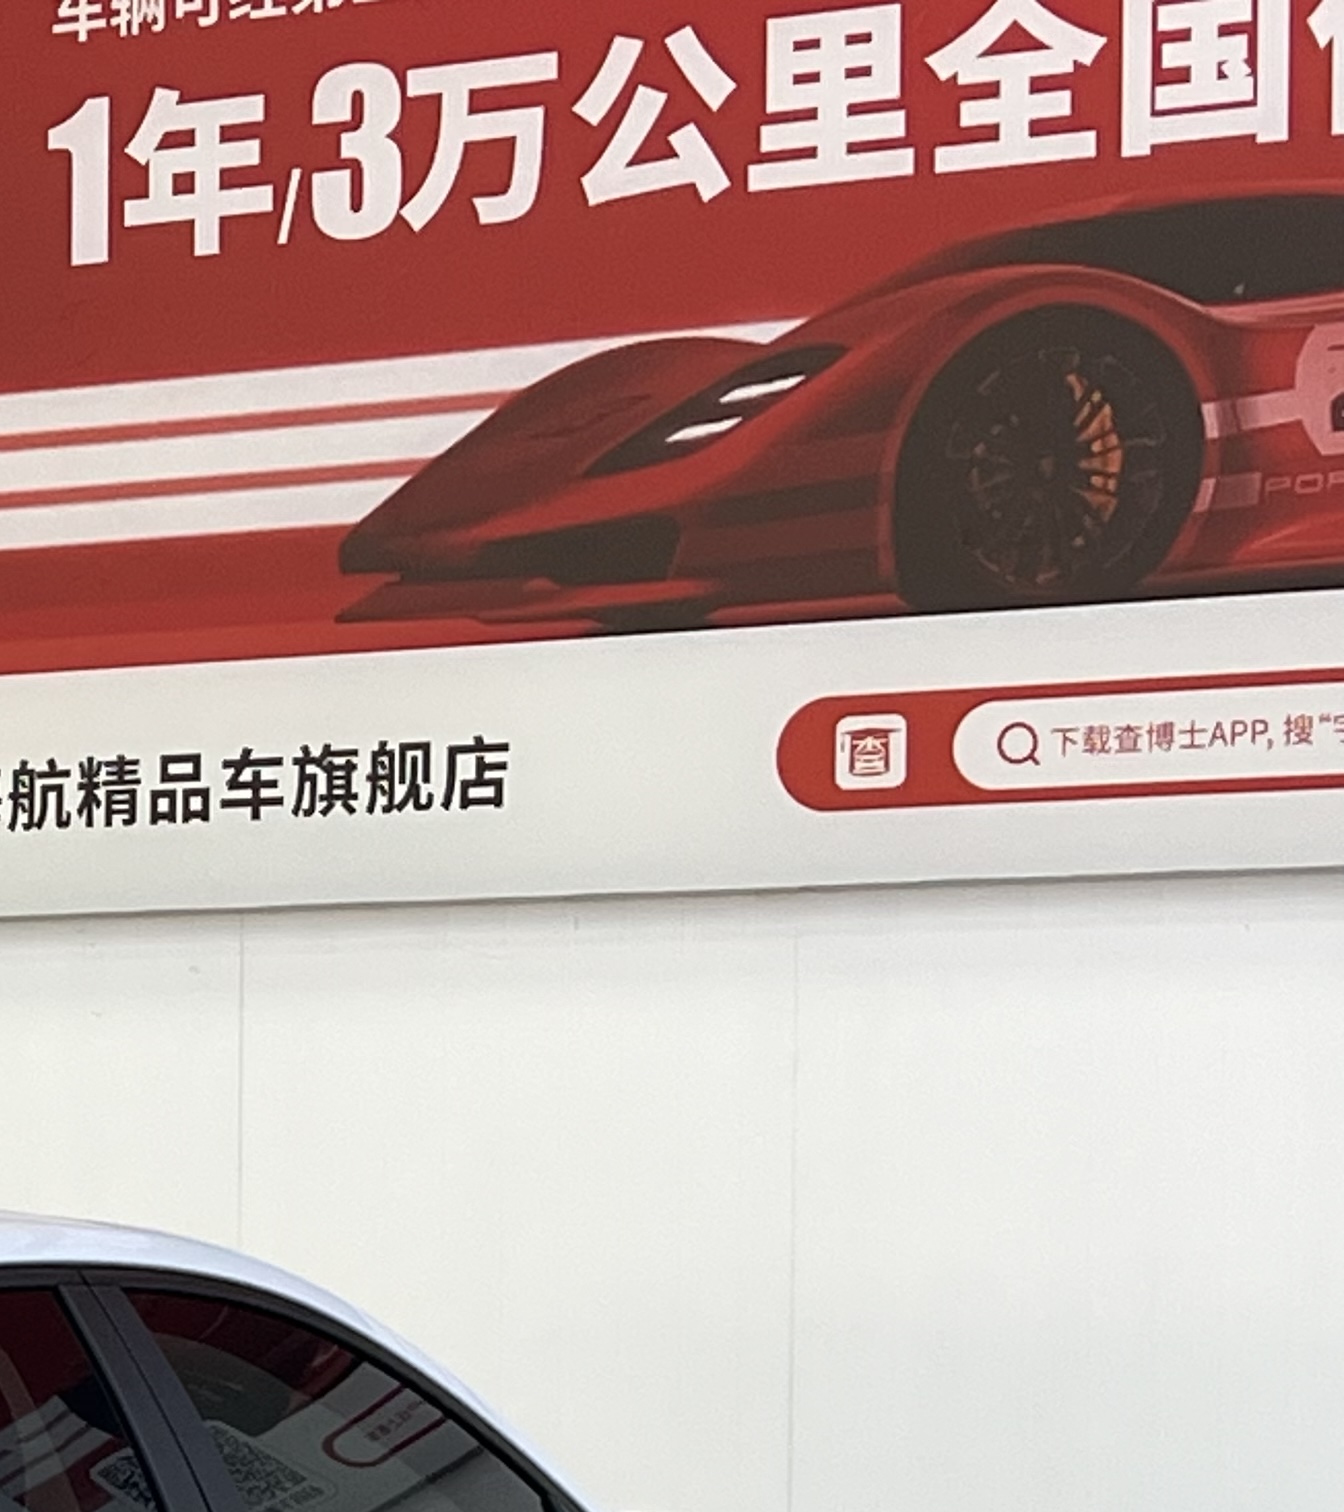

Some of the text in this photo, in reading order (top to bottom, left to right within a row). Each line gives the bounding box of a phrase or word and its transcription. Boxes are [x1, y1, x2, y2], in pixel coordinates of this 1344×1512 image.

[47, 0, 1344, 267] 1年/3万公里全国
